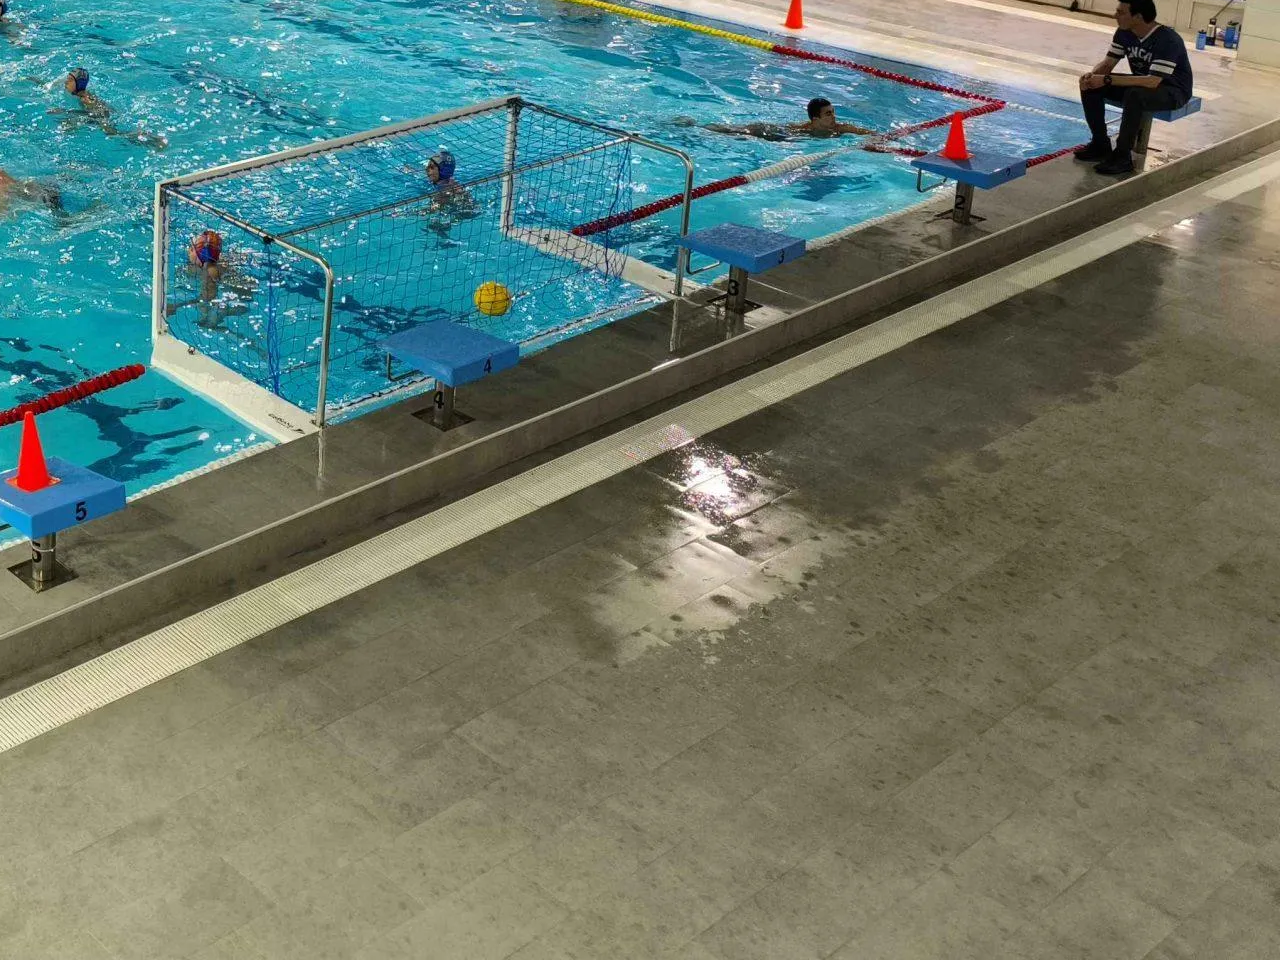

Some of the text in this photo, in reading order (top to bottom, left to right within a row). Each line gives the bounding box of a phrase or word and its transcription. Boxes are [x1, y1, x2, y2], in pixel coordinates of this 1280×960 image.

[954, 194, 965, 210] 2
[778, 248, 785, 264] 3
[727, 279, 739, 296] 3
[483, 358, 492, 374] 4
[433, 391, 444, 409] 4
[75, 501, 87, 521] 5
